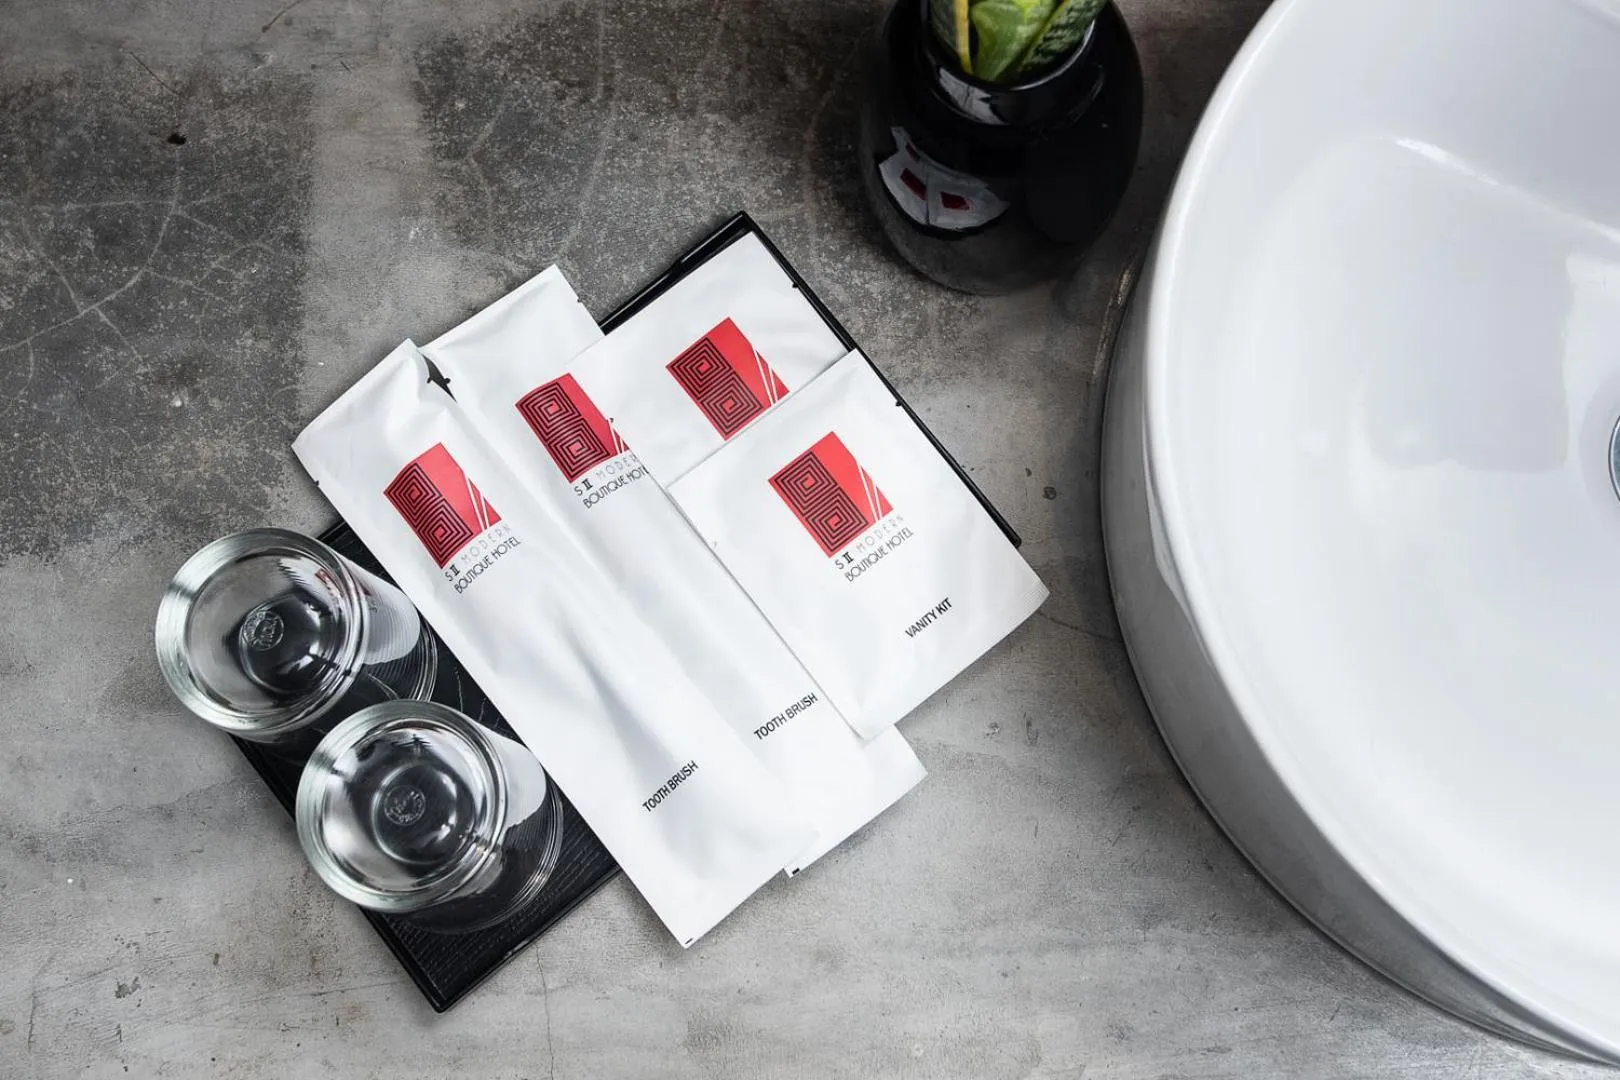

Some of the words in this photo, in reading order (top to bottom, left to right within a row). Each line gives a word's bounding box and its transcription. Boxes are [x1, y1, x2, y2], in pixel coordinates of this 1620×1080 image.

[582, 475, 629, 509] BOUTIQUE
[453, 555, 494, 594] BOUTIQUE
[490, 536, 521, 560] HOTEL
[461, 524, 511, 563] MODERN
[844, 545, 888, 582] BOUTIQUE
[885, 527, 914, 551] HOTEL
[904, 609, 938, 638] VANITY
[935, 597, 952, 615] KIT
[753, 713, 788, 740] TOOTH
[784, 692, 819, 719] BRUSH
[642, 784, 671, 812] TOOTH
[667, 759, 699, 791] BRUSH
